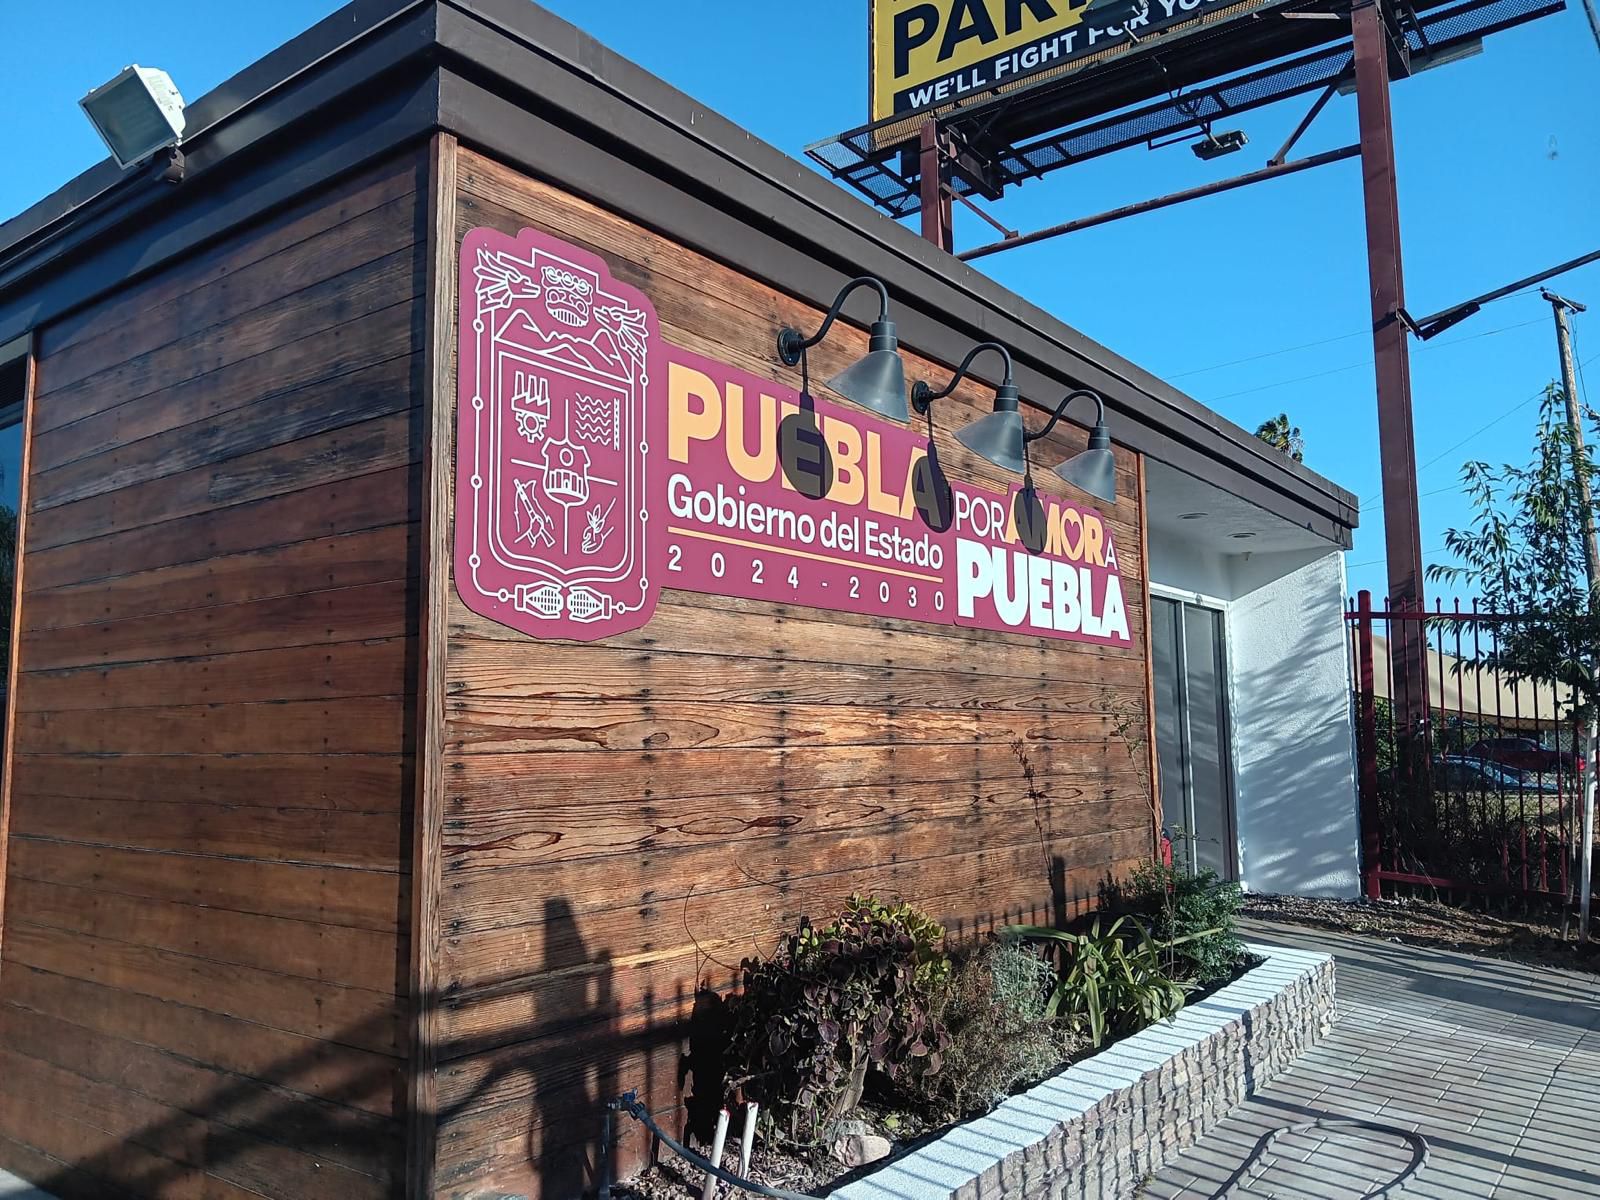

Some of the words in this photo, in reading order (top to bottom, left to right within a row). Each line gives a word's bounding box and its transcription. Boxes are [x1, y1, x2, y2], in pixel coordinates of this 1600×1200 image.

[894, 0, 1087, 79] PA
[909, 77, 986, 109] WE'LL
[995, 31, 1081, 80] FIGHT
[668, 361, 943, 528] PUEBLA
[668, 473, 815, 544] Gobierno
[820, 511, 859, 553] del
[865, 521, 944, 570] Estado
[955, 491, 1005, 542] POR
[1005, 491, 1105, 567] AMOR
[1104, 536, 1118, 570] A
[956, 538, 1130, 641] PUEBLA
